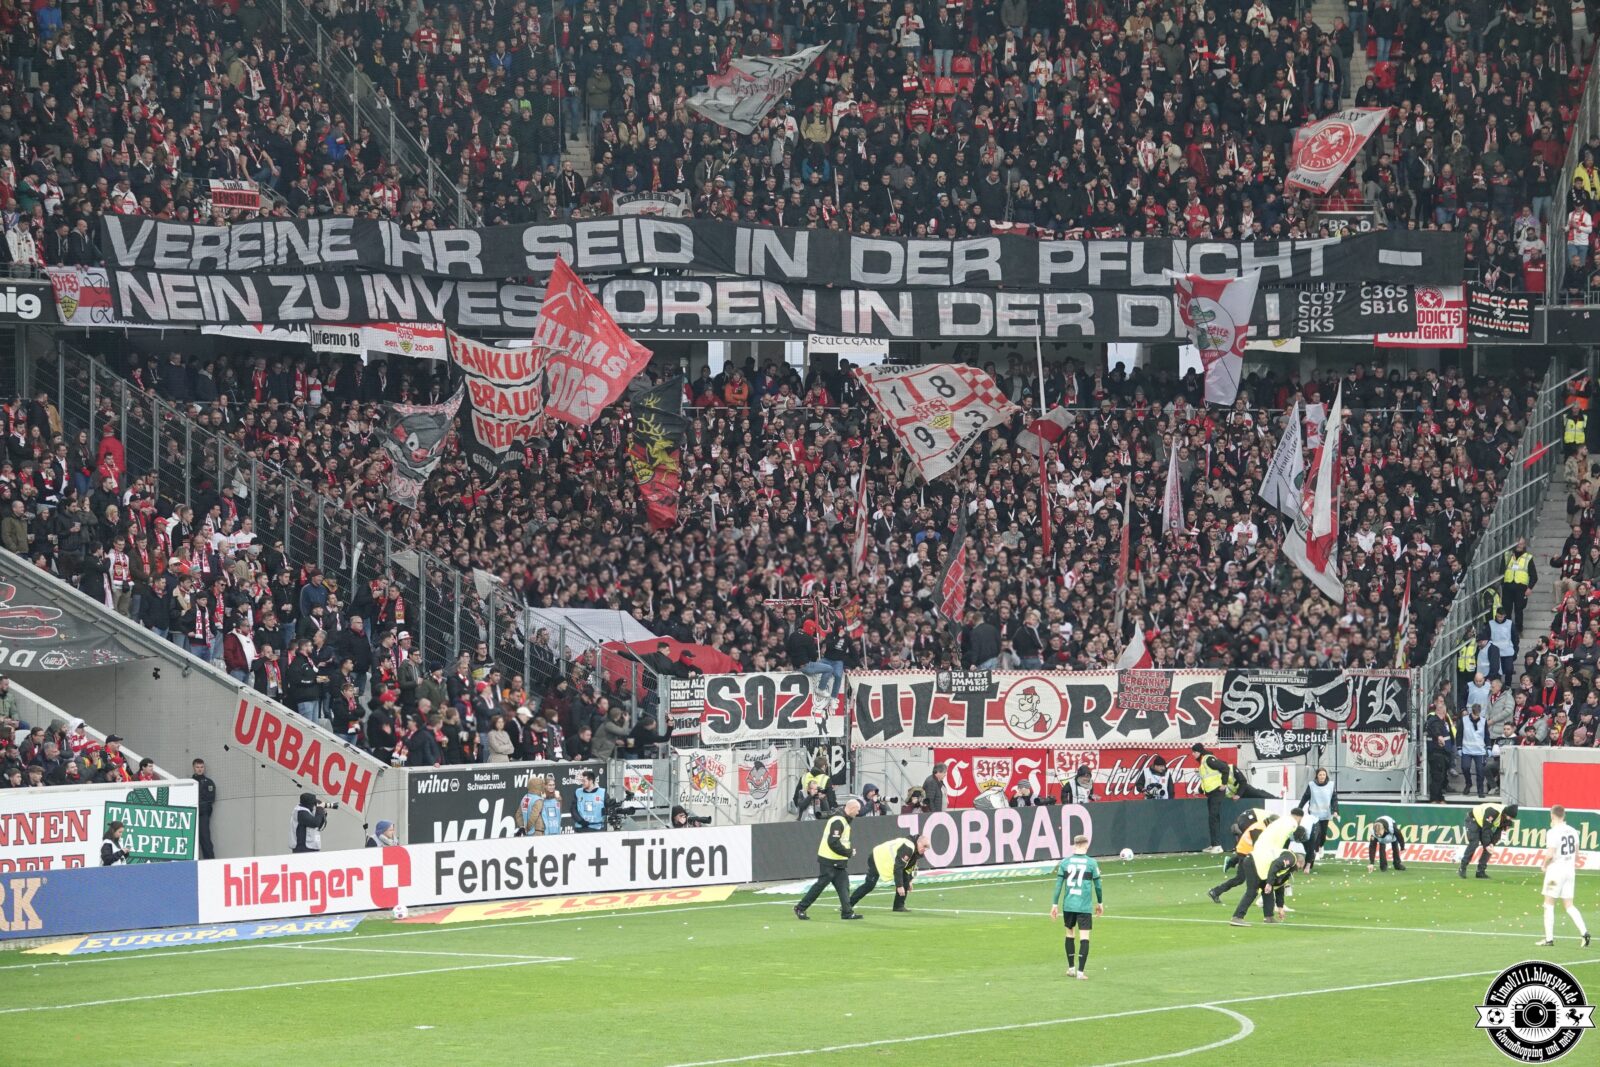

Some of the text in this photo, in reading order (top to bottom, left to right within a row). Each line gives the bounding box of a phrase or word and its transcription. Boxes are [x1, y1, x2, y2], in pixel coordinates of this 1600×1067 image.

[104, 215, 358, 270] VEREINE
[379, 219, 483, 275] IHR
[522, 218, 694, 272] SEID
[735, 226, 808, 278] IN
[850, 236, 1002, 286] DER
[1038, 236, 1341, 286] PFLICHT
[115, 271, 262, 322] NEIN
[269, 275, 350, 320] ZU
[361, 274, 817, 332] INVESOREN
[840, 289, 914, 336] IN
[937, 292, 1096, 336] DER
[1299, 290, 1346, 305] CC97
[1360, 300, 1409, 316] SB16
[1472, 292, 1529, 311] NECKAR
[1298, 320, 1335, 333] SKS
[1418, 310, 1462, 325] DDICTS
[1468, 314, 1529, 332] HALUNKEN
[312, 330, 360, 347] Inferno 18
[536, 315, 628, 379] ULTRAS
[928, 375, 956, 399] 8
[913, 410, 989, 450] 9 3
[952, 678, 988, 686] IMMER
[857, 682, 1214, 741] ULTRAS
[1283, 729, 1330, 744] Suebia
[234, 699, 373, 814] URBACH
[1354, 755, 1397, 770] Stuttgart
[417, 774, 449, 794] wiha
[467, 781, 506, 792] Schwarzwald
[474, 774, 489, 782] Made
[109, 807, 193, 830] TANNEN
[119, 829, 188, 856] ÄPFLE
[1560, 834, 1576, 856] 28
[434, 838, 728, 896] Fenster + Türen
[1066, 864, 1087, 888] 27
[223, 862, 364, 914] hilzinger
[560, 889, 702, 908] LOTTO
[80, 917, 357, 949] EUROPA PARK
